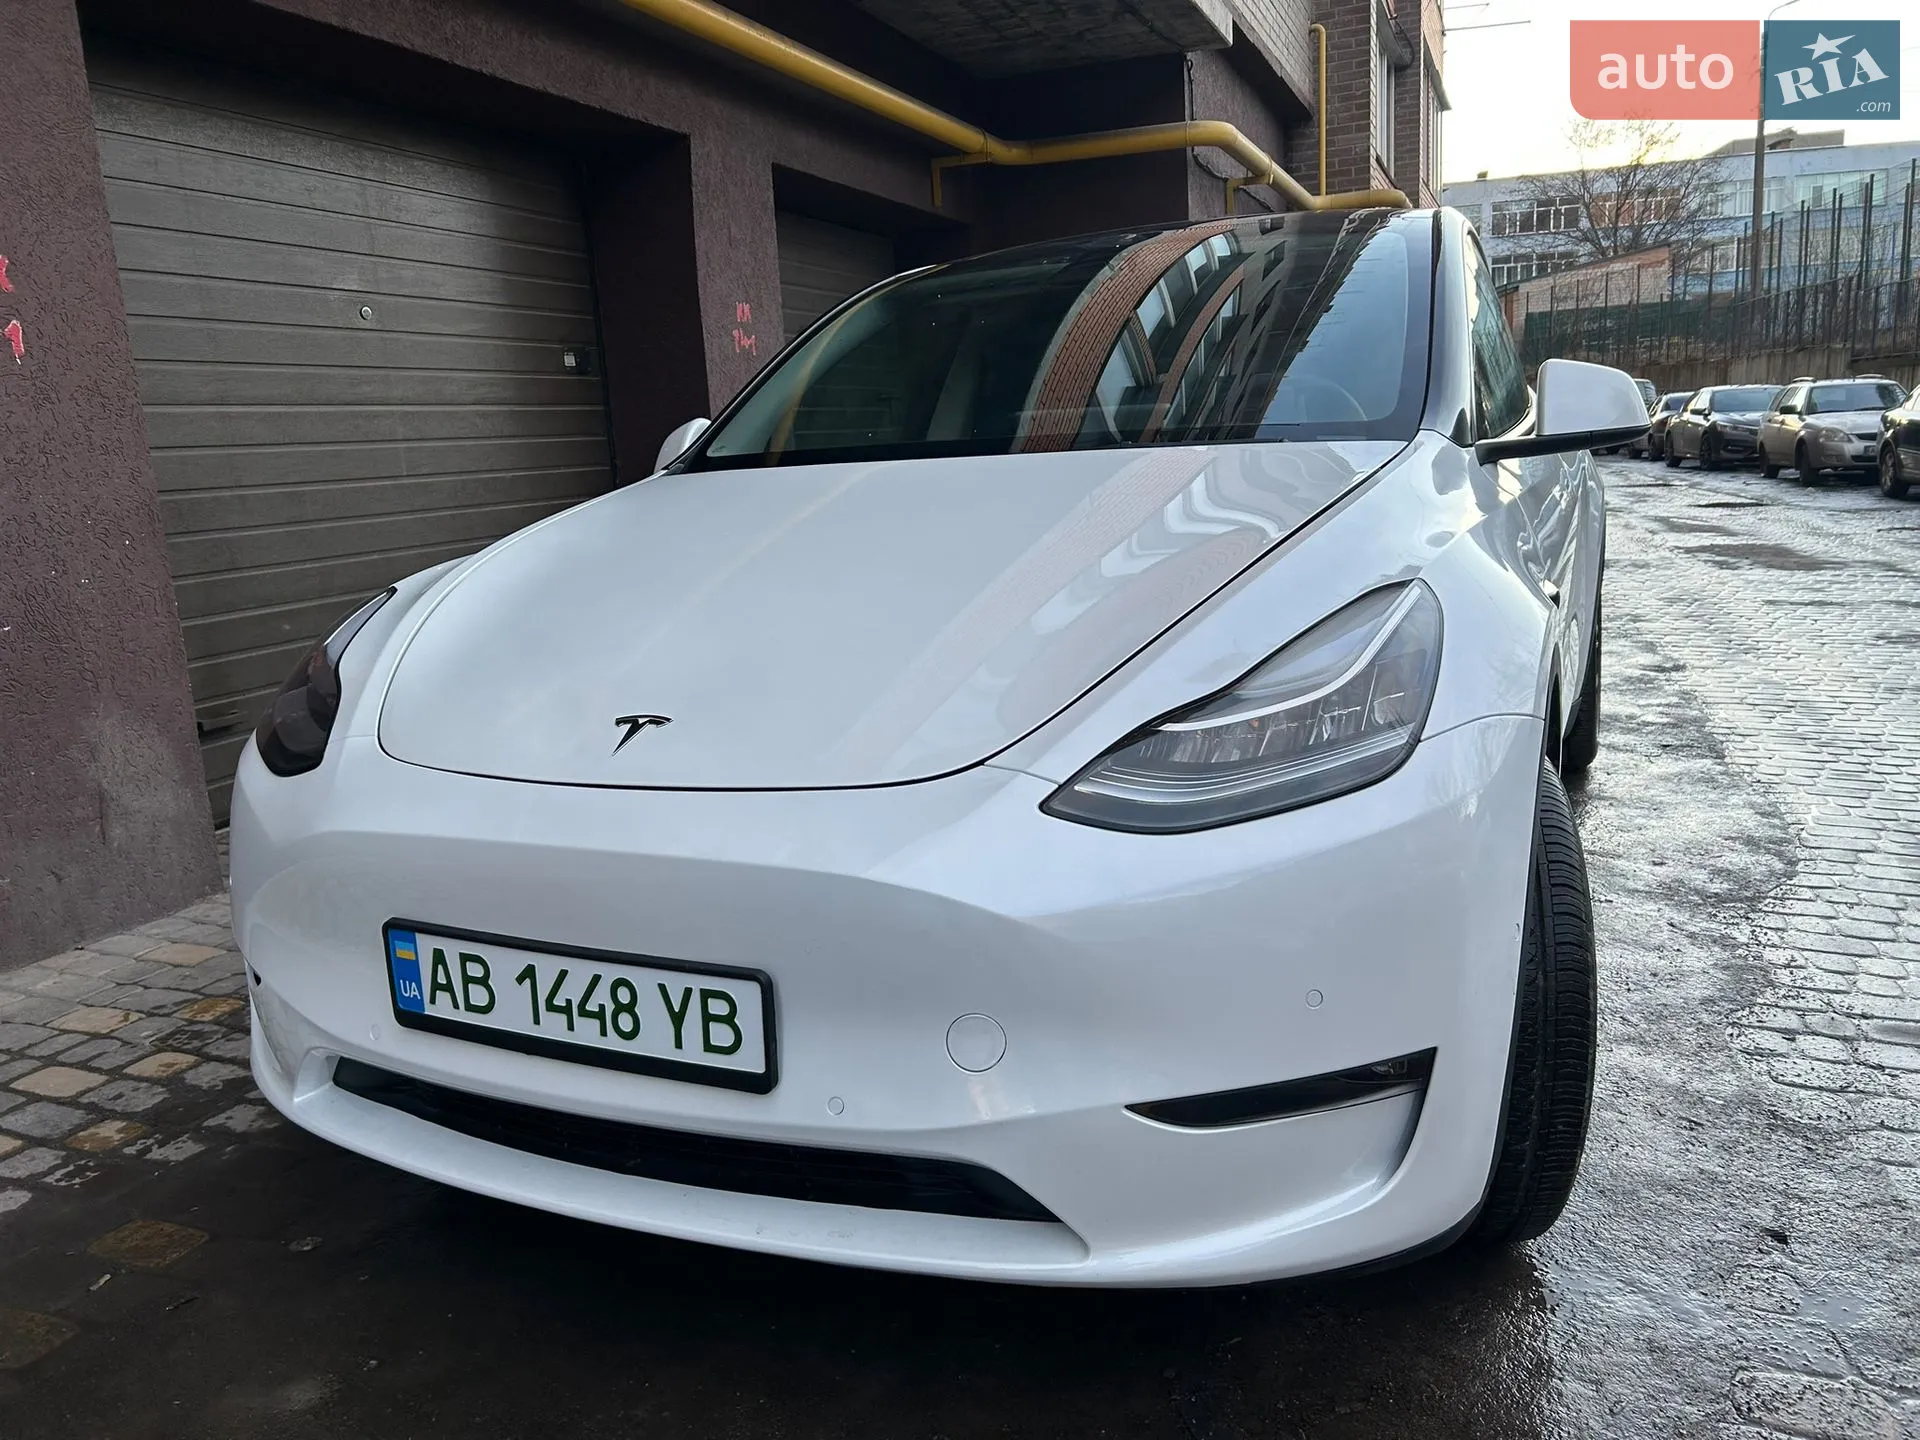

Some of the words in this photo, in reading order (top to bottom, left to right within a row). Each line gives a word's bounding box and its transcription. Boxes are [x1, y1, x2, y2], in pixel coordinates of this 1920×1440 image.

[400, 979, 421, 1001] UA
[429, 947, 497, 1015] AB
[514, 963, 641, 1041] 1448
[657, 982, 743, 1056] YB
